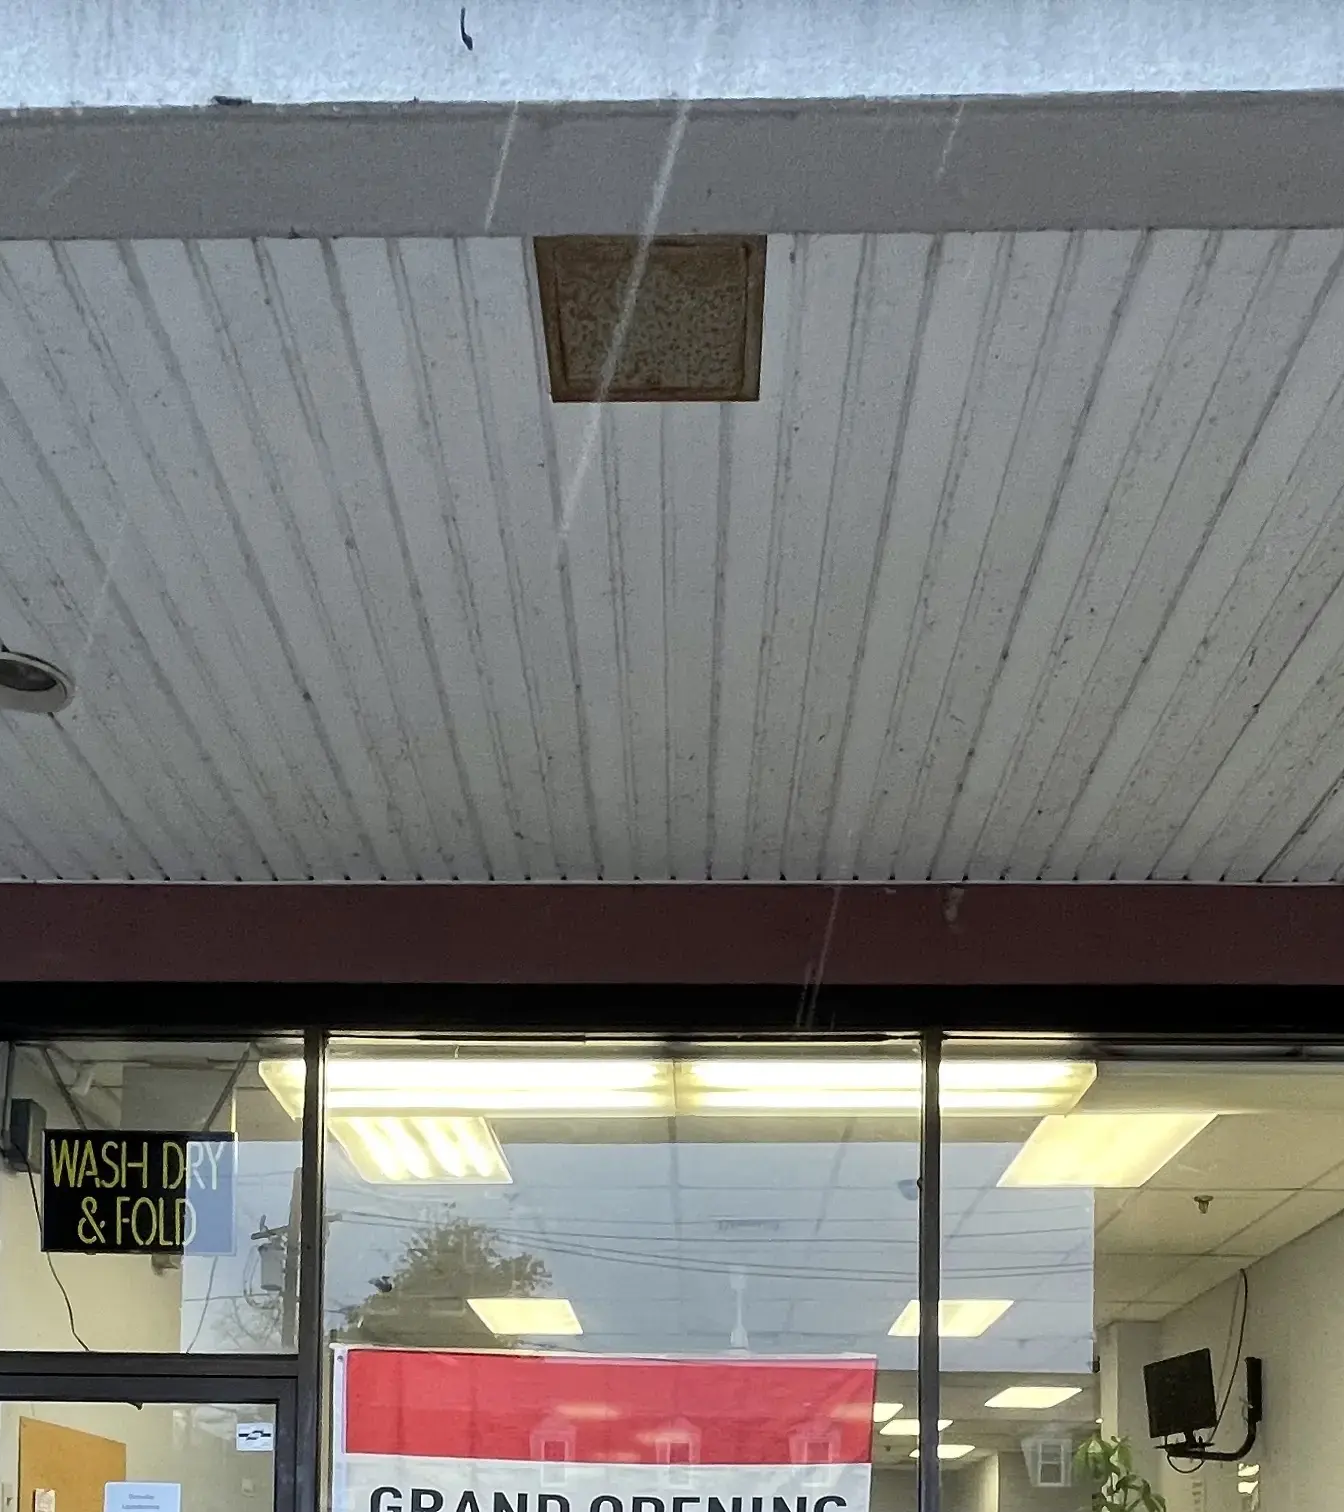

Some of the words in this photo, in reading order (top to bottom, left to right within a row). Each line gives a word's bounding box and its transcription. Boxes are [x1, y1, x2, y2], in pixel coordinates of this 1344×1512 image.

[50, 1139, 148, 1189] WASH
[162, 1140, 225, 1190] DRY
[77, 1196, 106, 1245] &
[116, 1196, 197, 1246] FOLD
